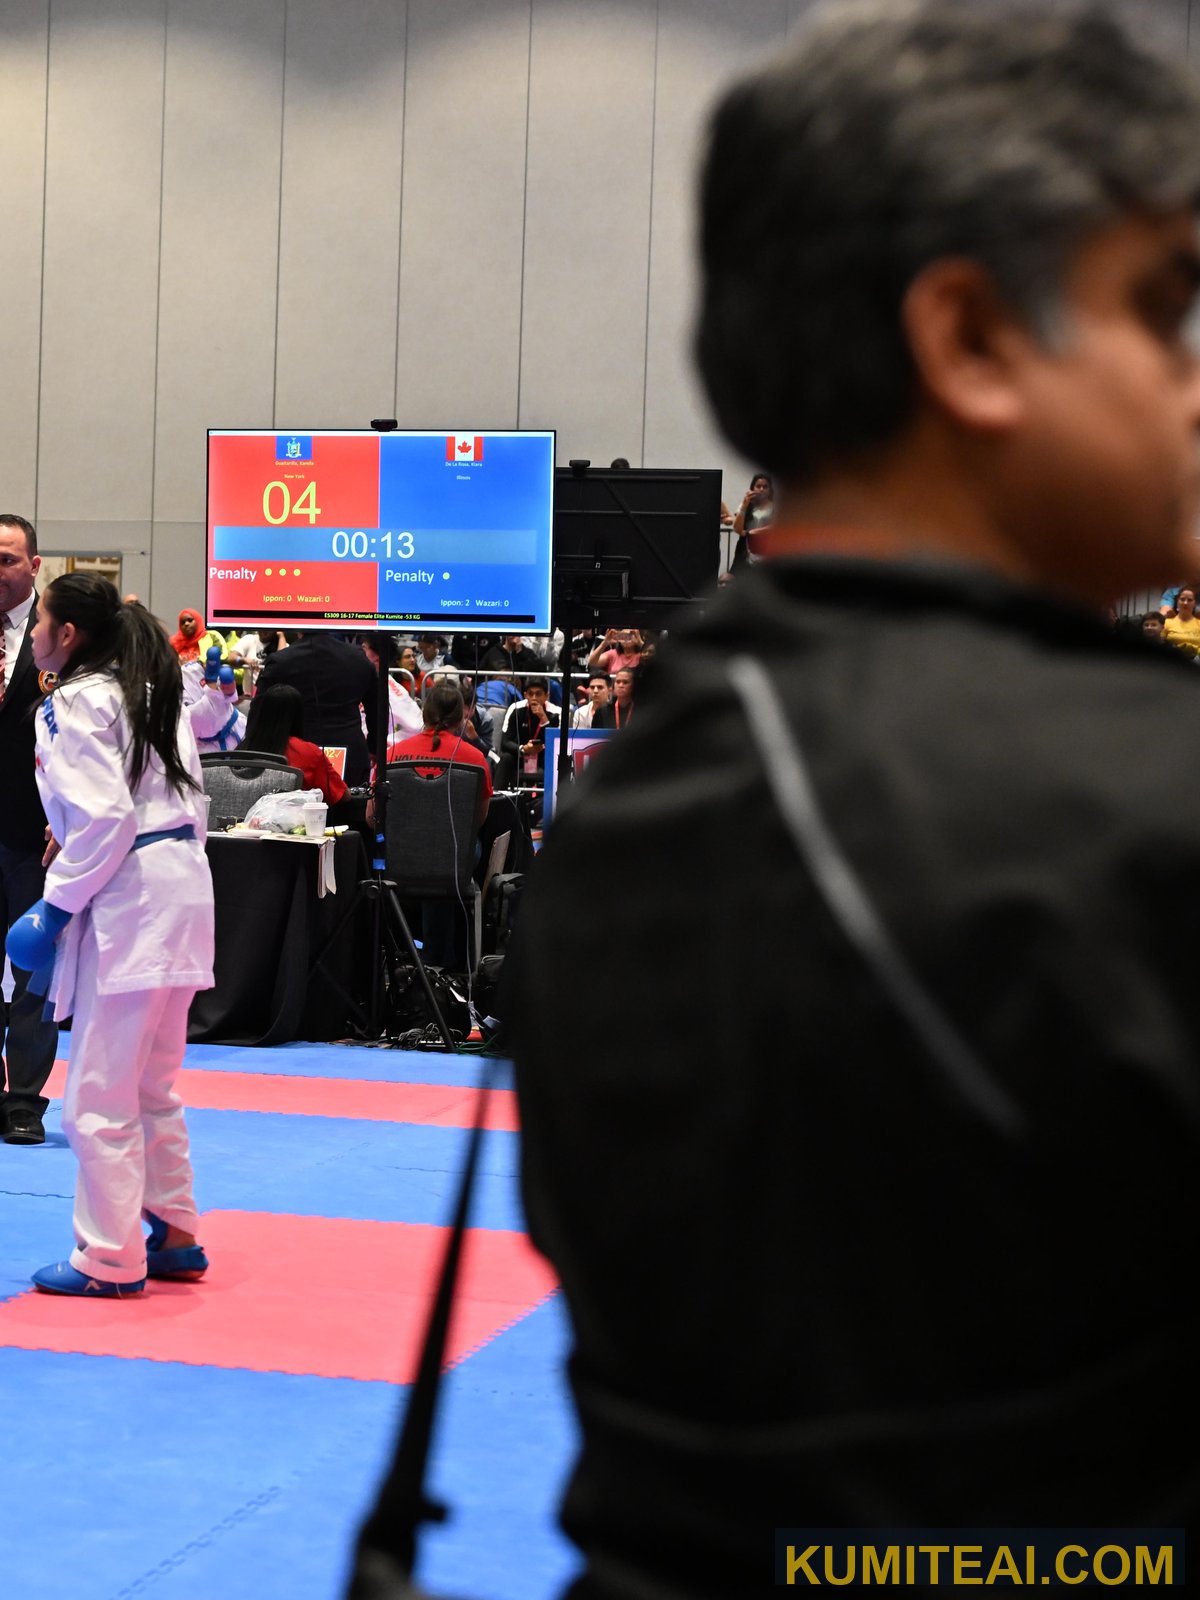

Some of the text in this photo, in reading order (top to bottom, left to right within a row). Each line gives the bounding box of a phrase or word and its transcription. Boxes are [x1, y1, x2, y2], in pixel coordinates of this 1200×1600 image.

[262, 481, 321, 525] 04
[332, 531, 415, 559] 00:13
[209, 567, 257, 582] Penalty
[385, 569, 434, 585] Penalty
[263, 594, 286, 603] Ippon:
[297, 595, 324, 603] Wazari:
[325, 595, 330, 603] 0
[440, 599, 464, 607] Ippon:
[465, 599, 470, 607] 2
[475, 599, 502, 607] Wazari:
